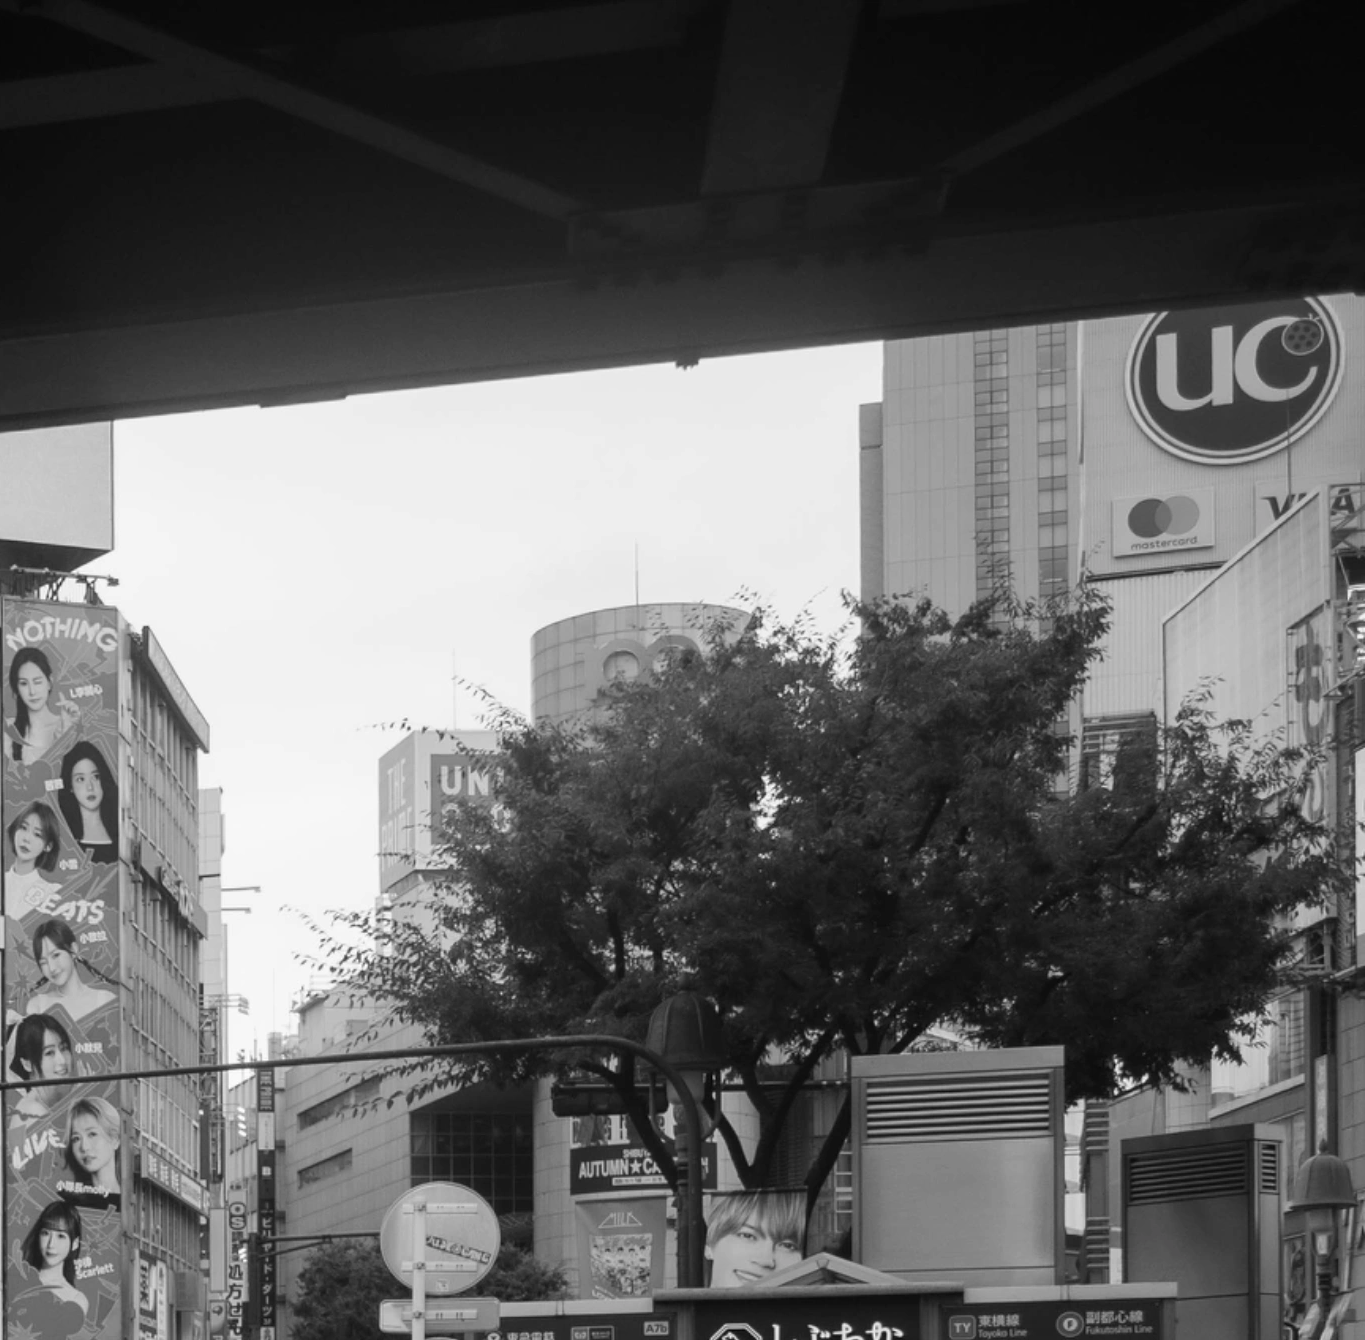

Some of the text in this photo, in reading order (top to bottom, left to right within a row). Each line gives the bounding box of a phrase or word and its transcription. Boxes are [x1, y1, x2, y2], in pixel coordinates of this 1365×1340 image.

[1130, 536, 1198, 550] mastercard
[6, 617, 117, 651] NOTHING
[25, 887, 105, 925] BEATS
[12, 1128, 67, 1169] LIVE
[978, 1314, 1020, 1328] 東横線
[1085, 1310, 1144, 1325] 副都心線
[646, 1324, 668, 1334] A7b
[954, 1322, 972, 1334] TY
[978, 1328, 1028, 1340] Toyoko Line
[1085, 1324, 1153, 1335] Fukutoshin Line
